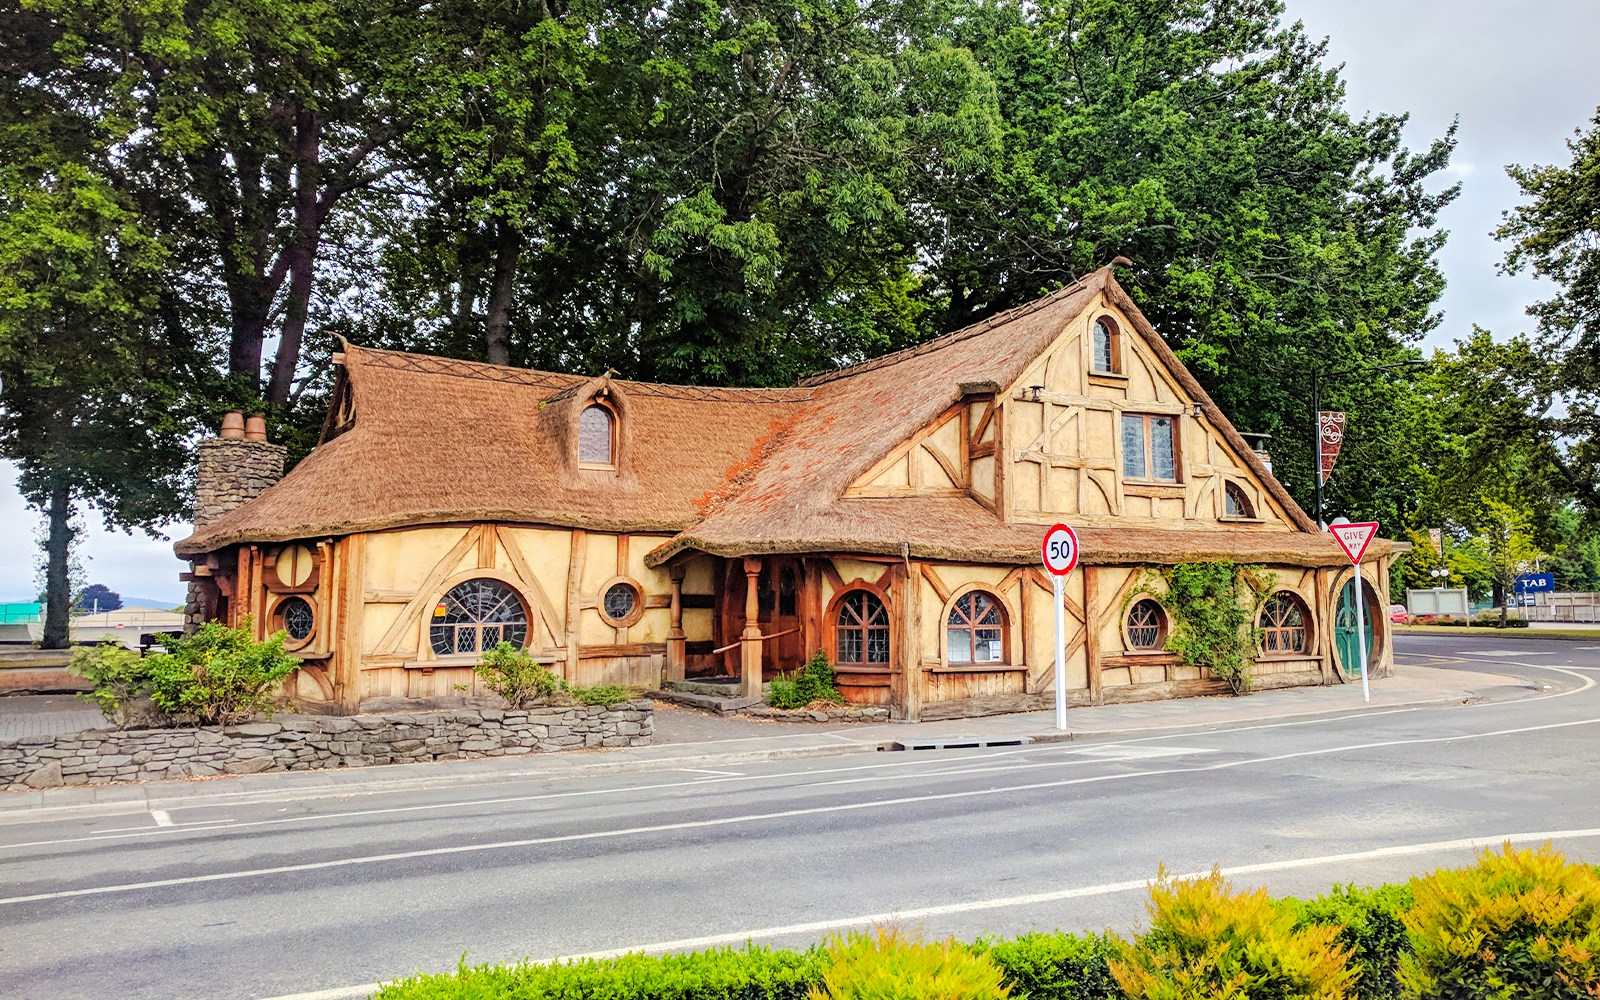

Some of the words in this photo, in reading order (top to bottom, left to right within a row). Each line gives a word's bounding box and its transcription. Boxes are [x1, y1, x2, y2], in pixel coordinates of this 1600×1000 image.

[1344, 531, 1364, 540] GIVE
[1051, 540, 1070, 560] 50
[1522, 578, 1547, 587] TAB
